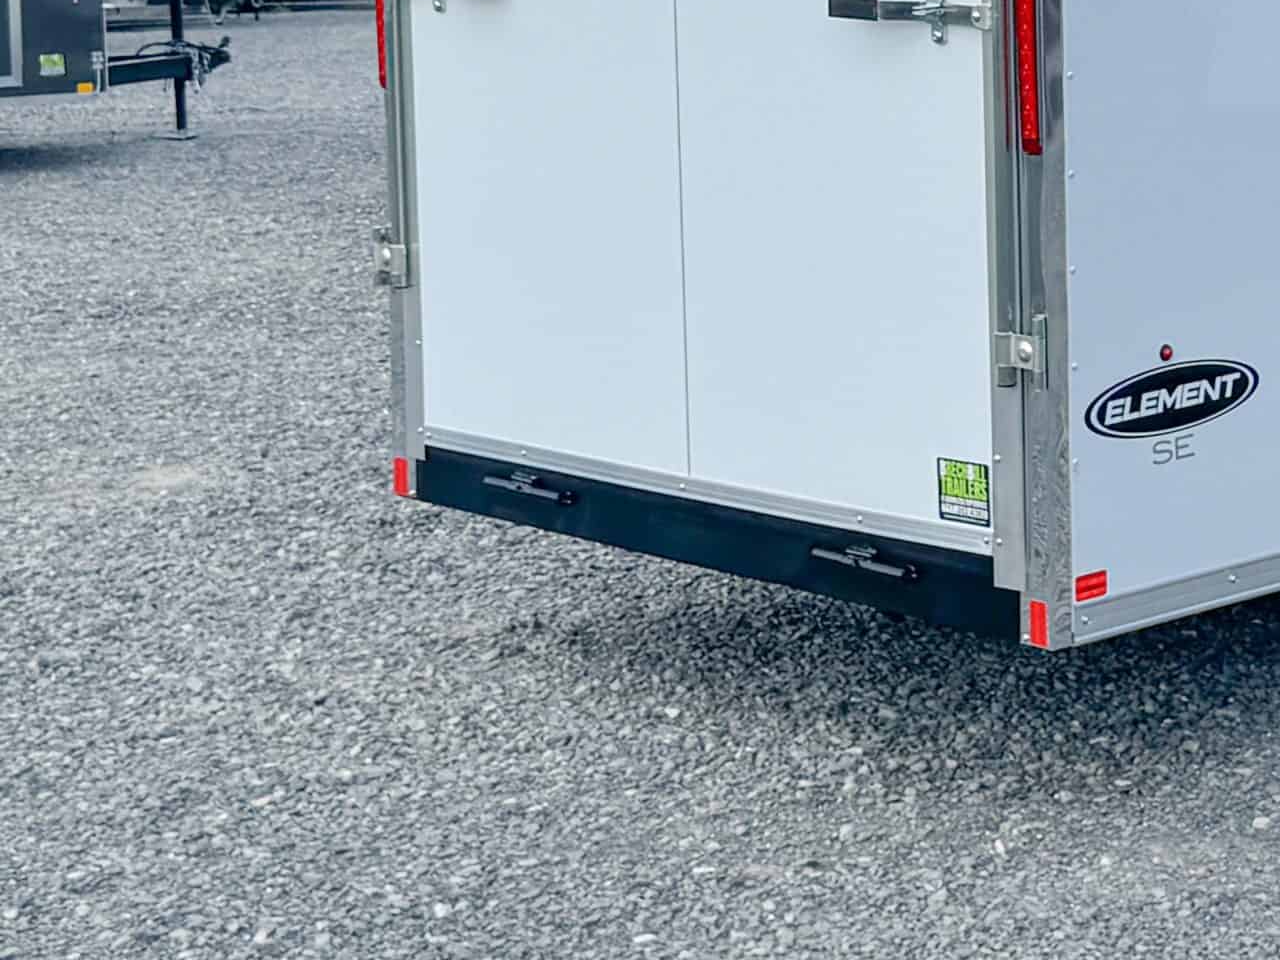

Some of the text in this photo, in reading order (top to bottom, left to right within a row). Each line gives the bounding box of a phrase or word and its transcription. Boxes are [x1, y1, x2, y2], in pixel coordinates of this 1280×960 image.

[1104, 372, 1242, 426] ELEMENT
[1152, 434, 1196, 465] SE
[942, 475, 988, 501] TRAILERS
